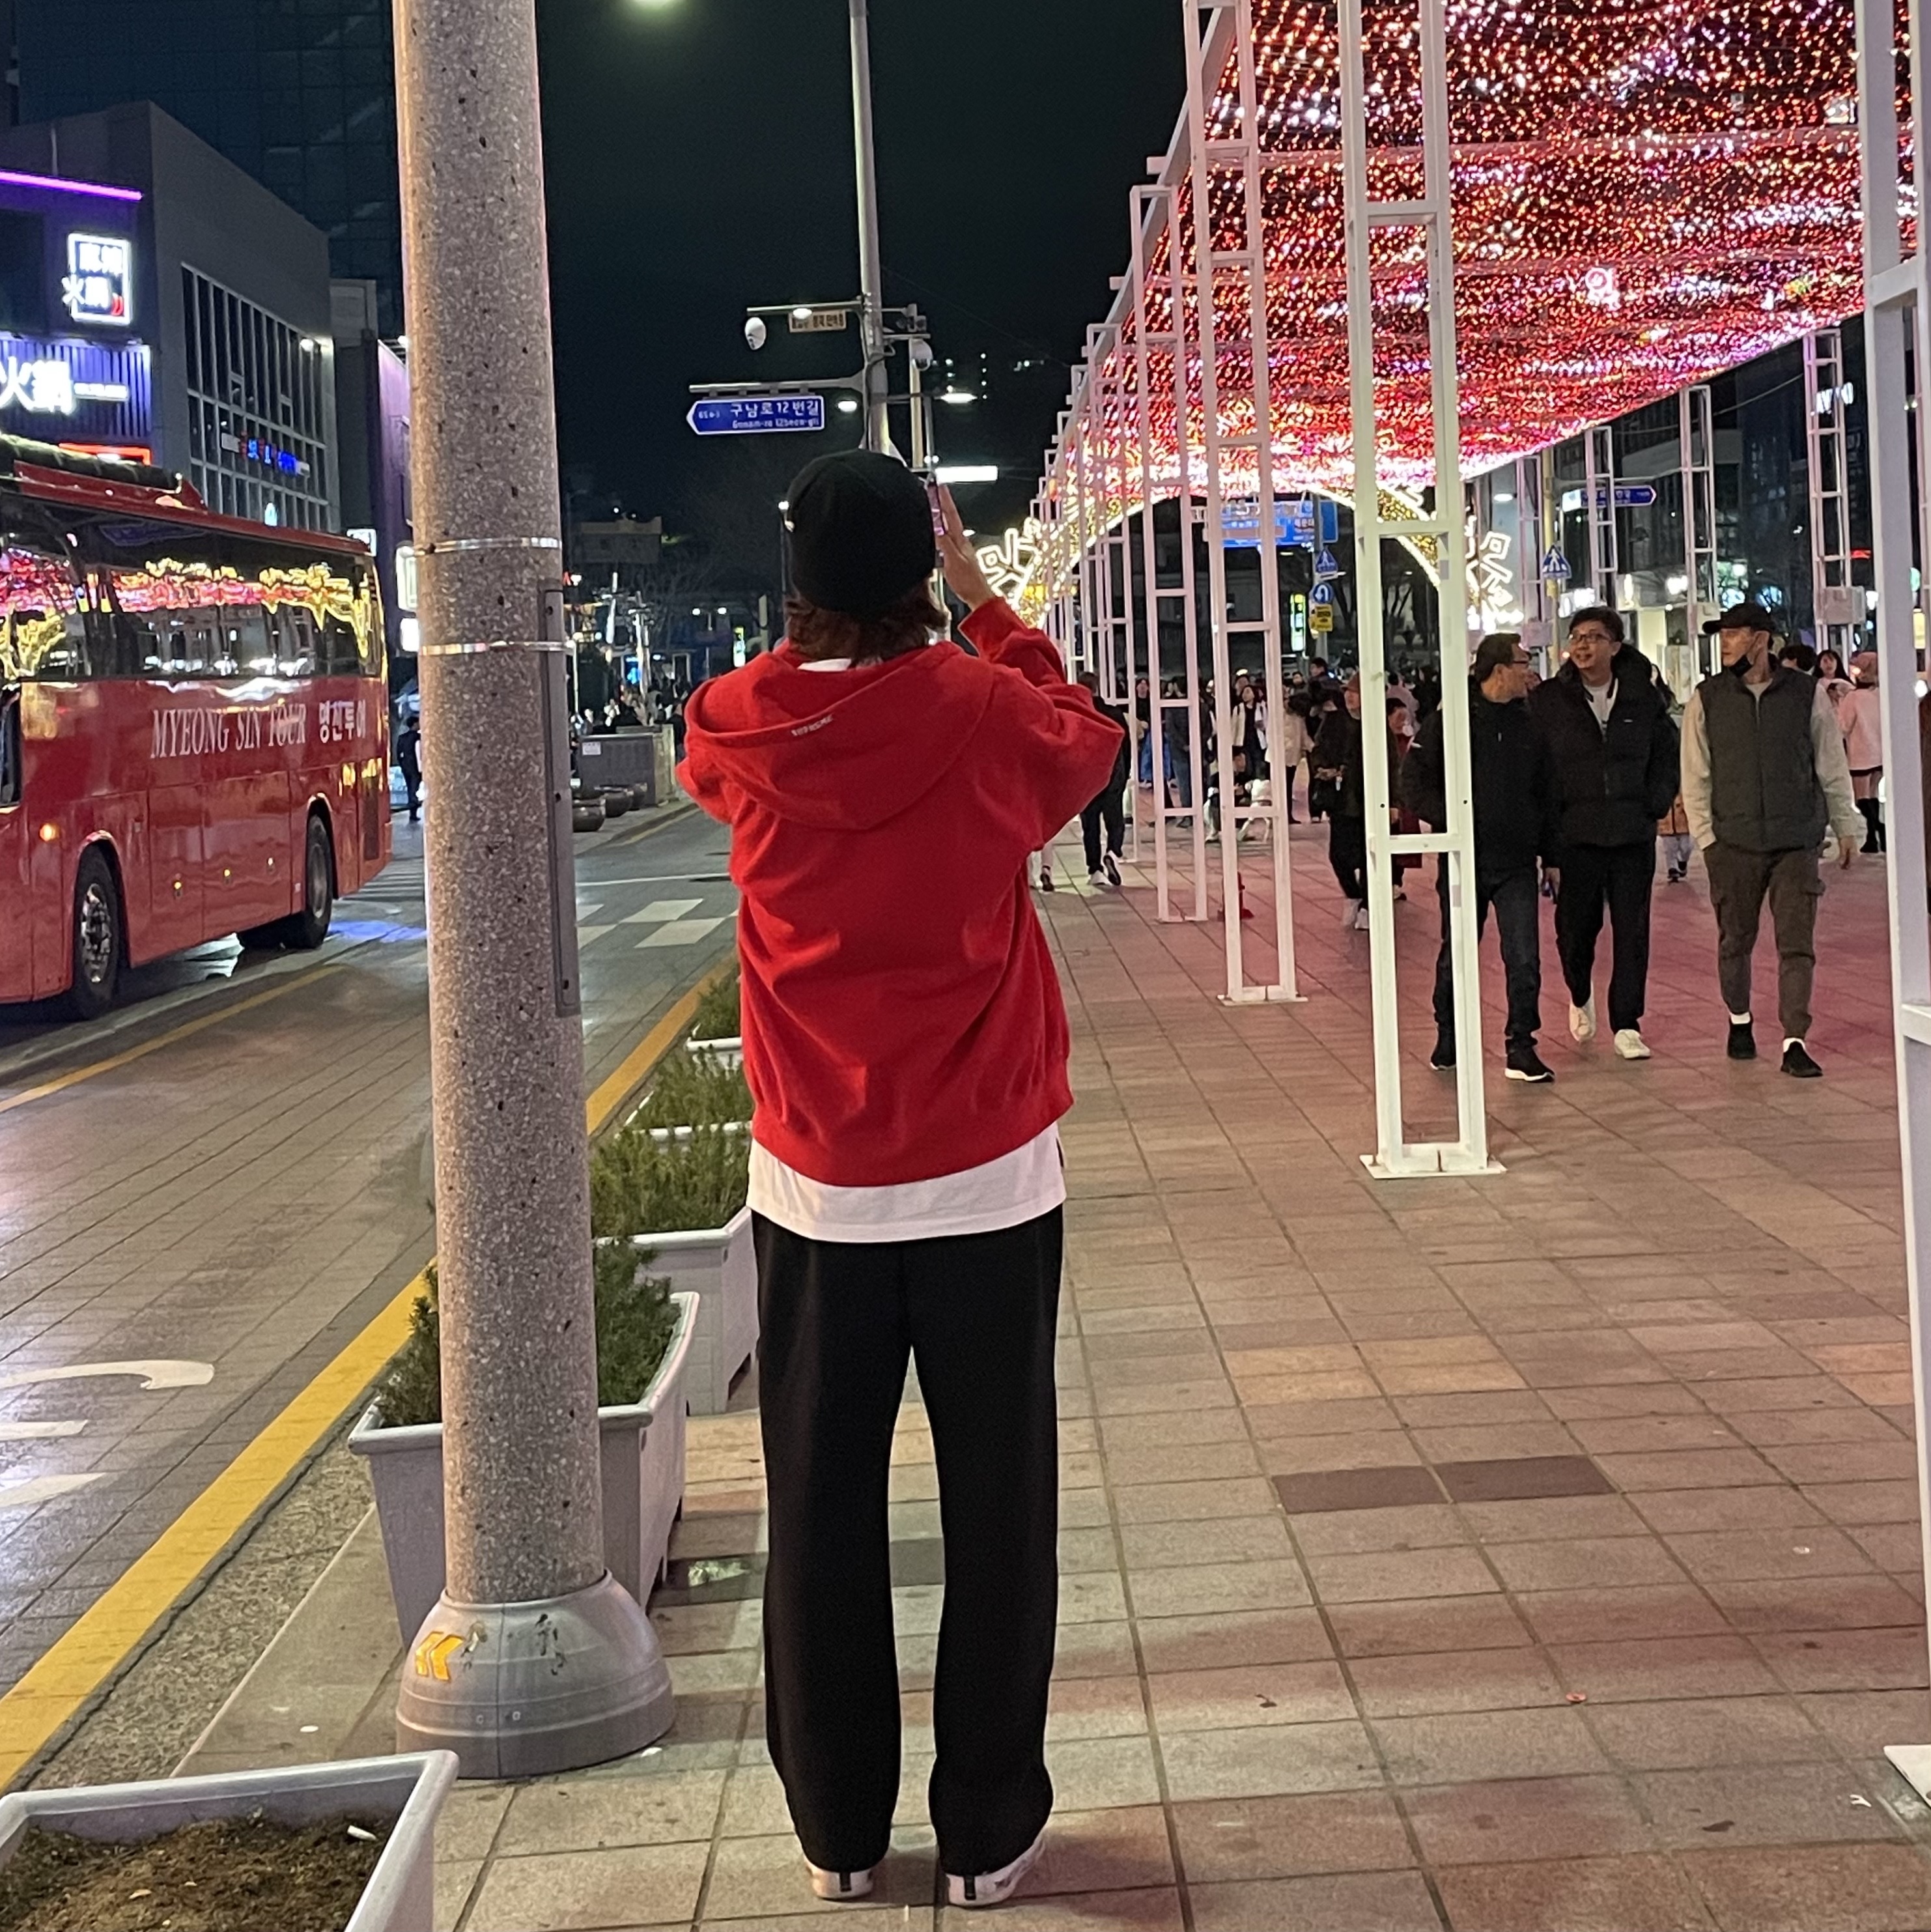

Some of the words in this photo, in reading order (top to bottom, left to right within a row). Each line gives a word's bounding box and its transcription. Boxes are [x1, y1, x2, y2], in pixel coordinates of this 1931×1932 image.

[150, 707, 229, 758] MYEONG
[236, 708, 264, 750] SIN
[267, 703, 306, 746] TOUR
